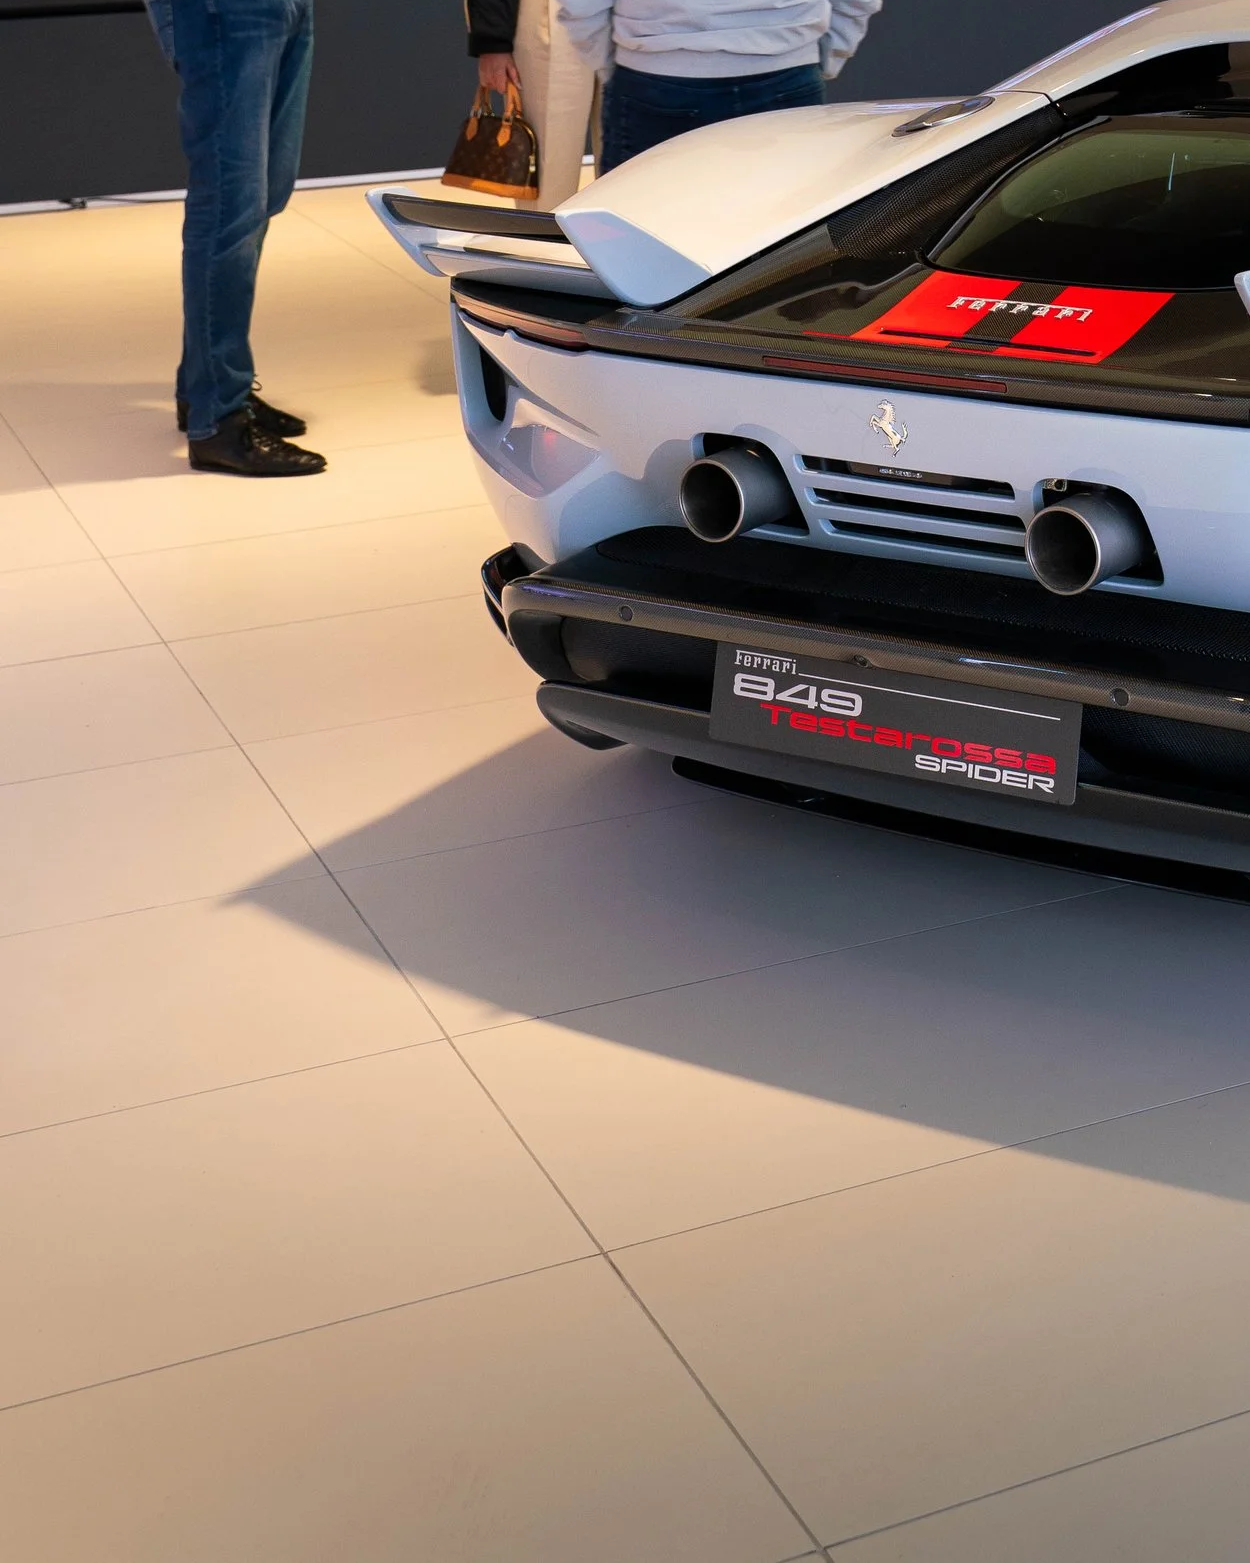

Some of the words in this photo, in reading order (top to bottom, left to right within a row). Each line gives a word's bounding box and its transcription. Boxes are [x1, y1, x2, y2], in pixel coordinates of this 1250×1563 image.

[946, 296, 1094, 322] Ferrari
[734, 650, 798, 675] Ferrari
[733, 673, 863, 717] 849
[760, 703, 1056, 774] Testarossa
[915, 754, 1055, 793] SPIDER
